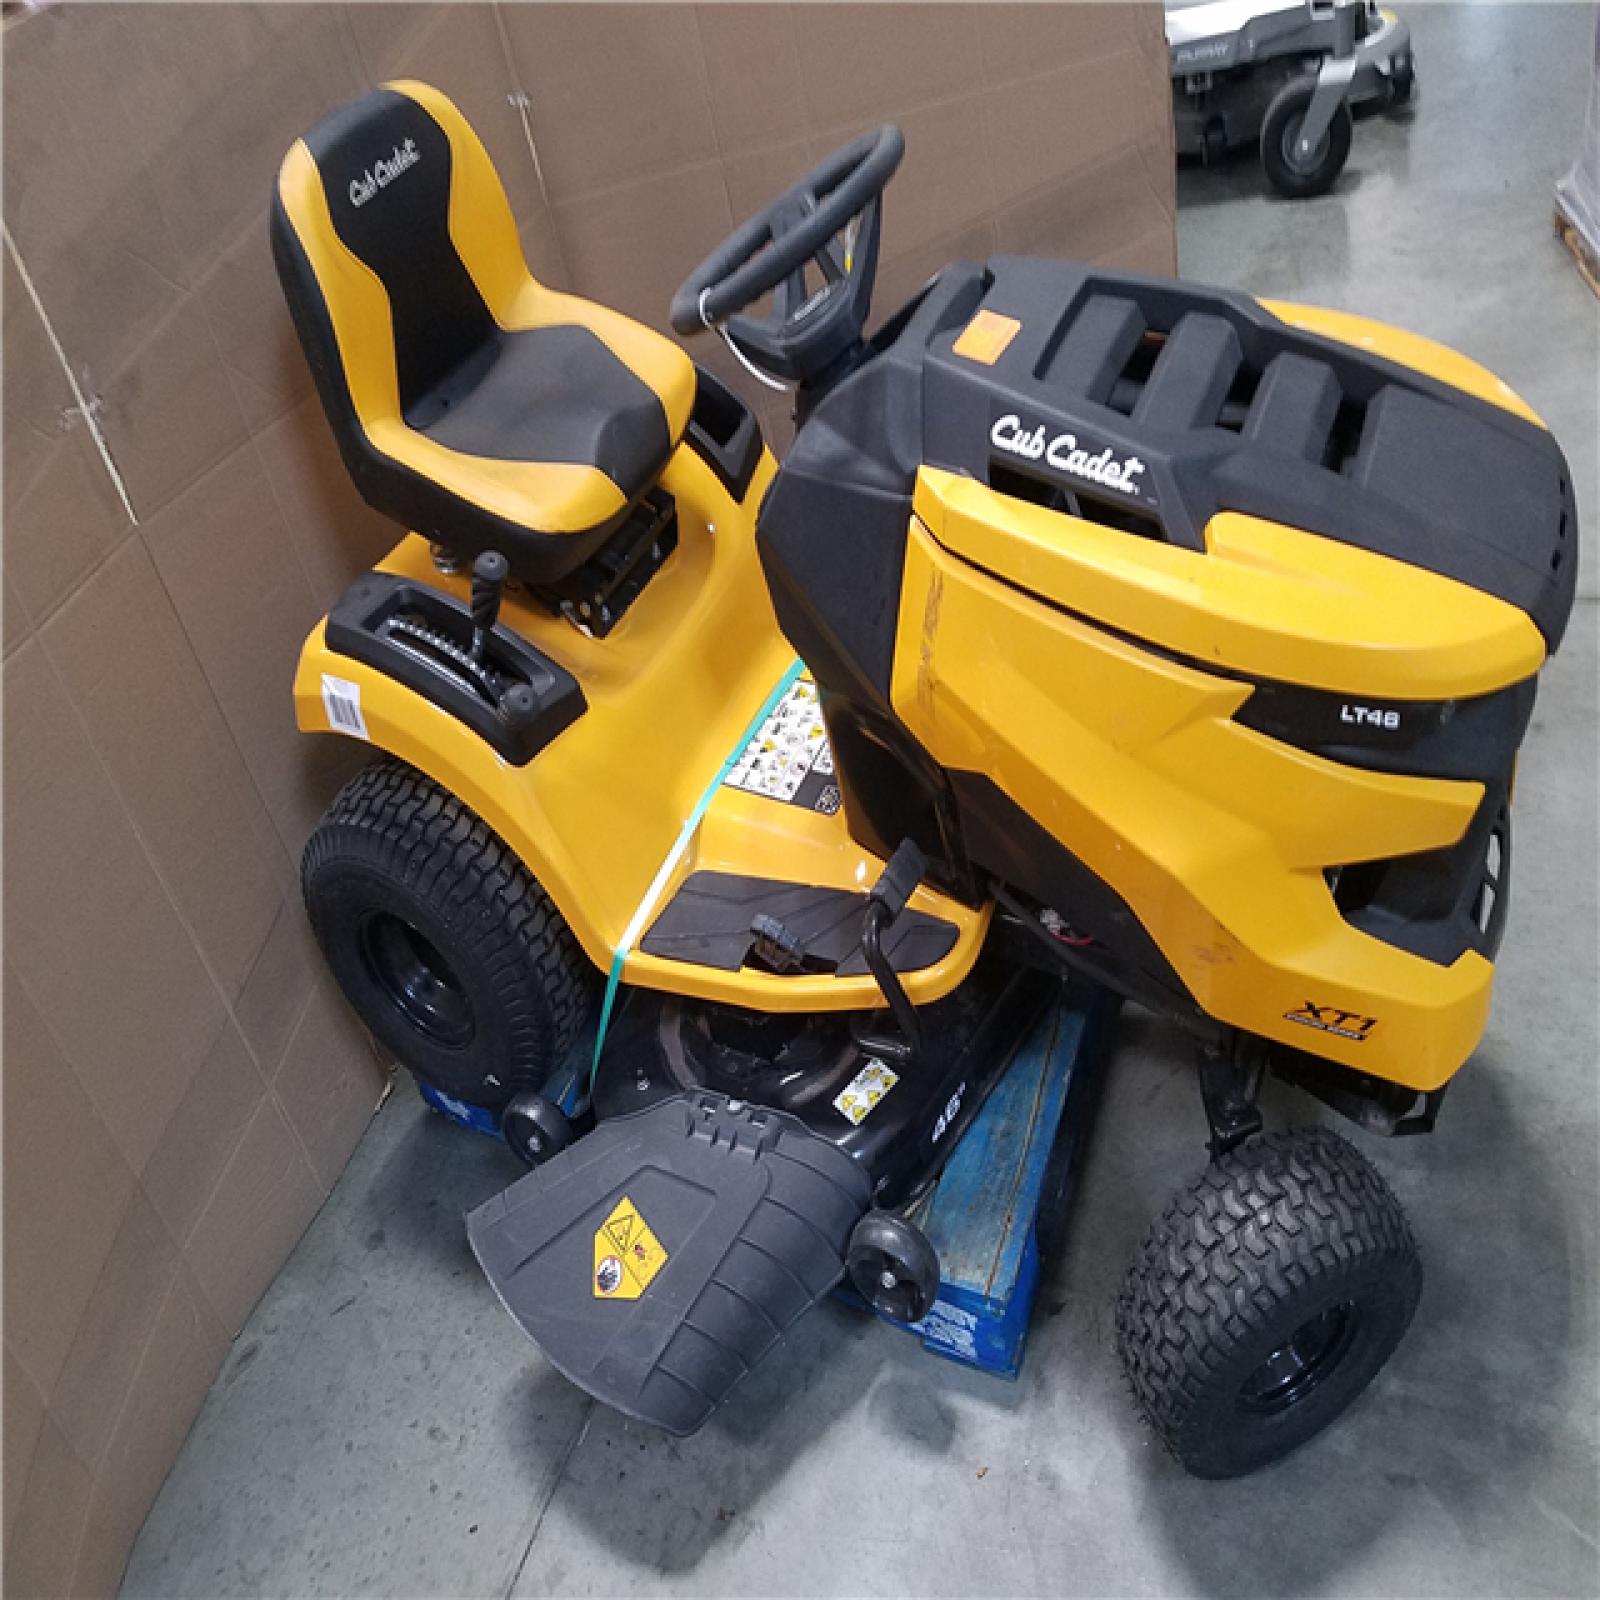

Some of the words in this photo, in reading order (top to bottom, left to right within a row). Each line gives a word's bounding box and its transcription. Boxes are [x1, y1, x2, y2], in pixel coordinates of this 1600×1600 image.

[990, 414, 1046, 459] Cub
[1046, 434, 1145, 493] Cadet
[1288, 1000, 1377, 1032] XT1
